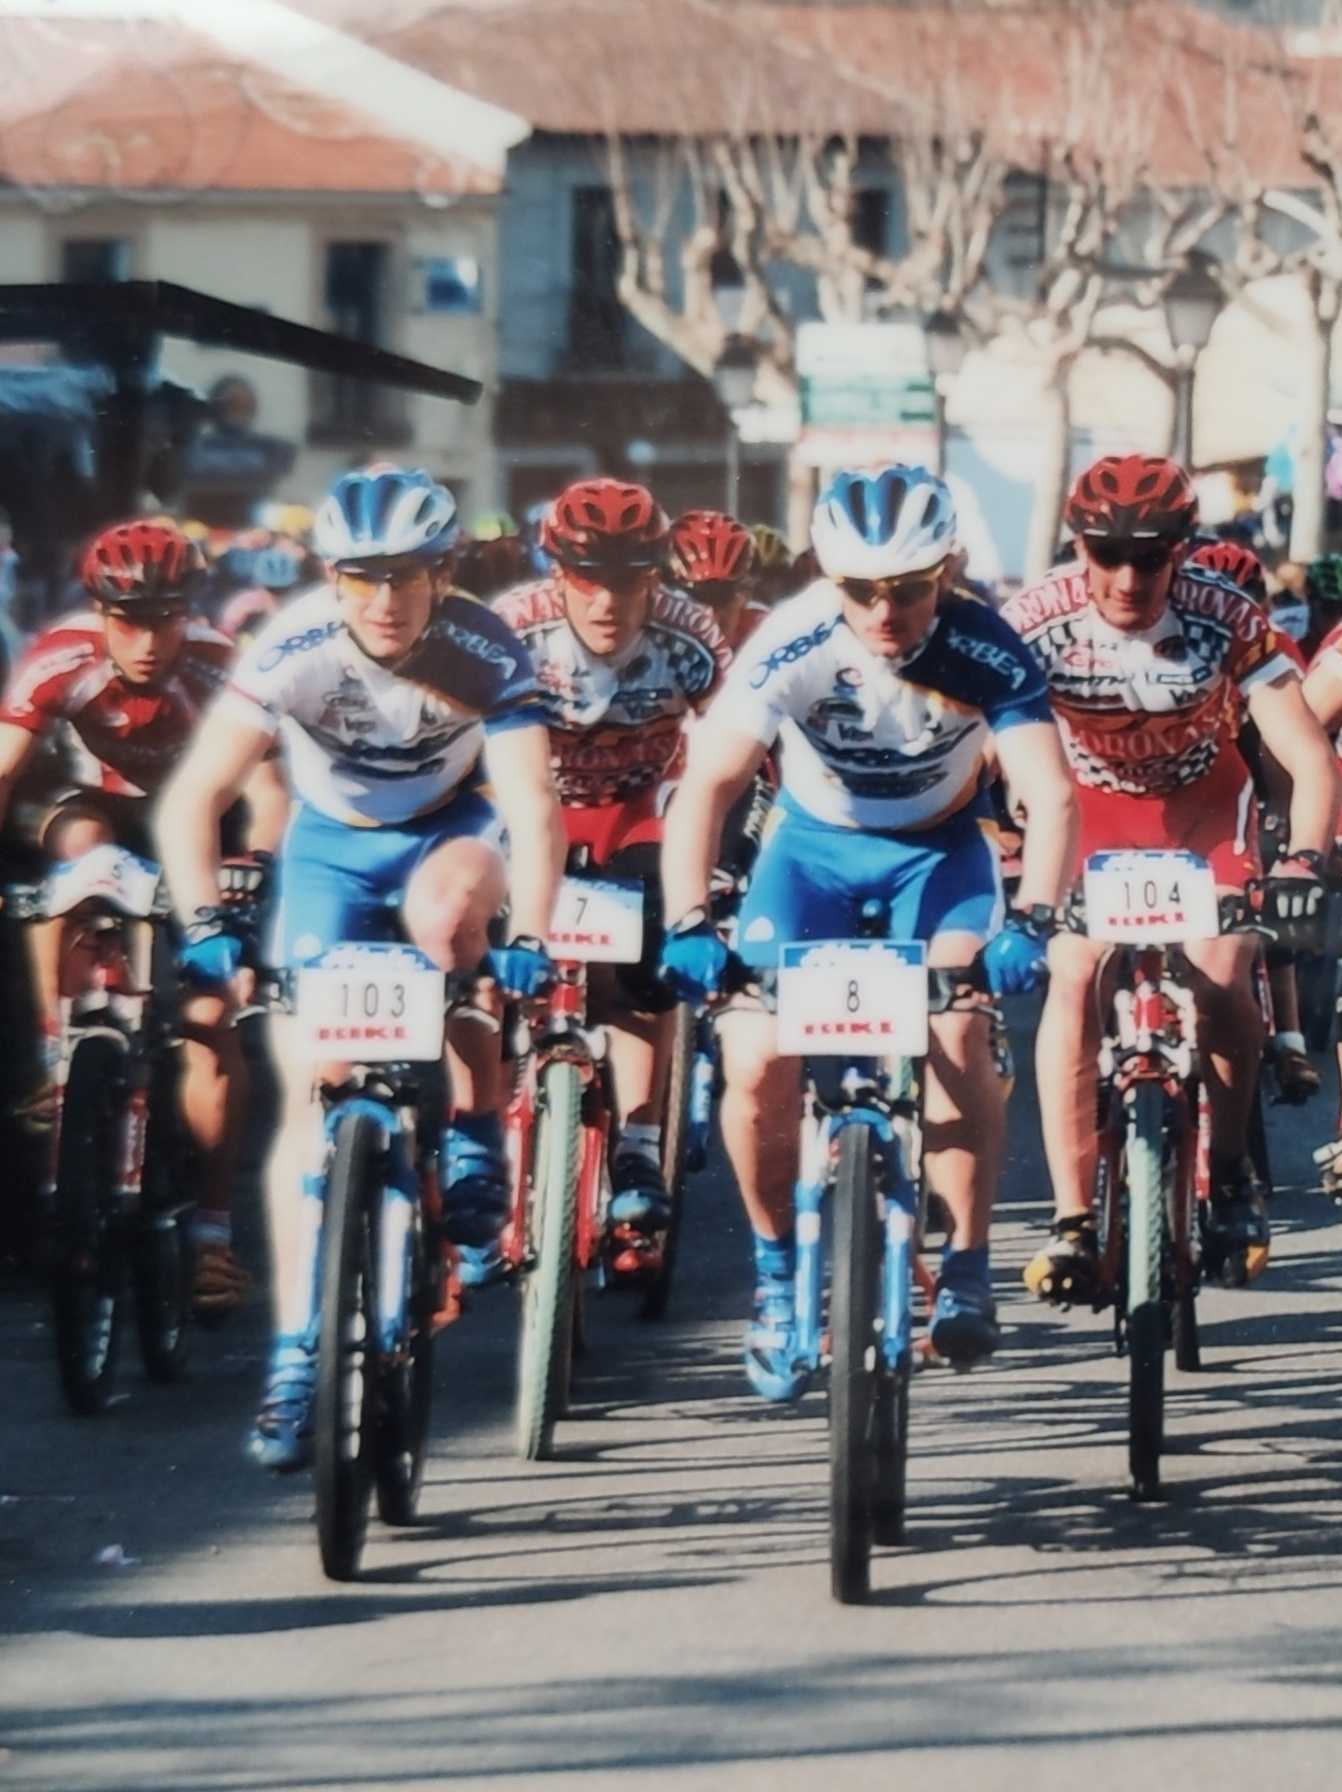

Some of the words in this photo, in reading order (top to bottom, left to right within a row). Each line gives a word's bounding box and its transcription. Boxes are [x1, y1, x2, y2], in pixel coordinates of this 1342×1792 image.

[1123, 880, 1181, 910] 104
[577, 897, 589, 926] 7
[341, 982, 406, 1019] 103
[846, 979, 861, 1013] 8
